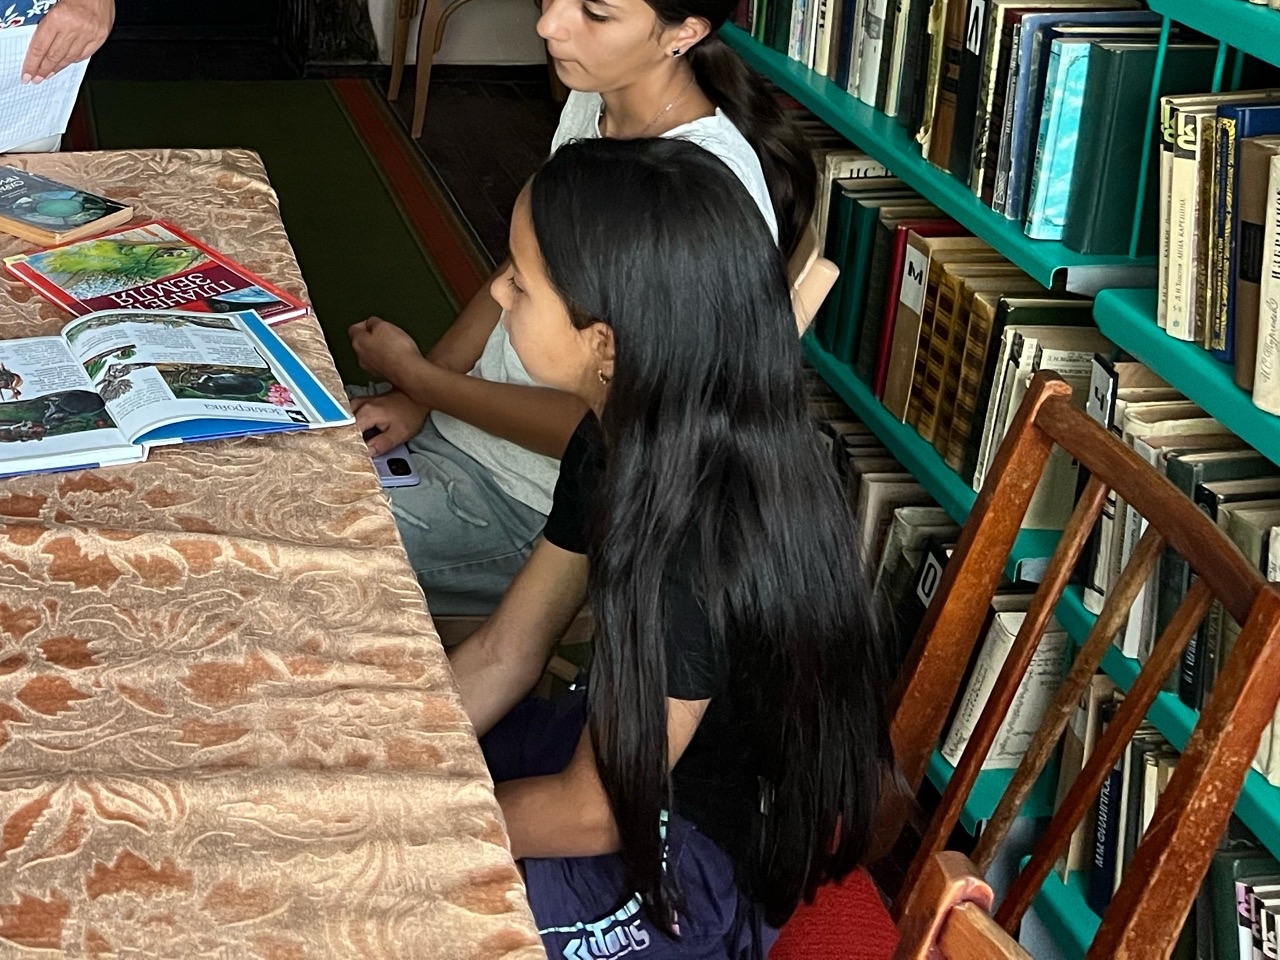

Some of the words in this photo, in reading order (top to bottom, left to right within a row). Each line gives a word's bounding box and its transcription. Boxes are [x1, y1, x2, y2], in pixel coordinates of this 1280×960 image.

[907, 260, 924, 286] М
[108, 273, 212, 306] ЗЕМЛЯ
[203, 402, 285, 417] Землеройка
[1097, 777, 1111, 841] ФИЛИППО
